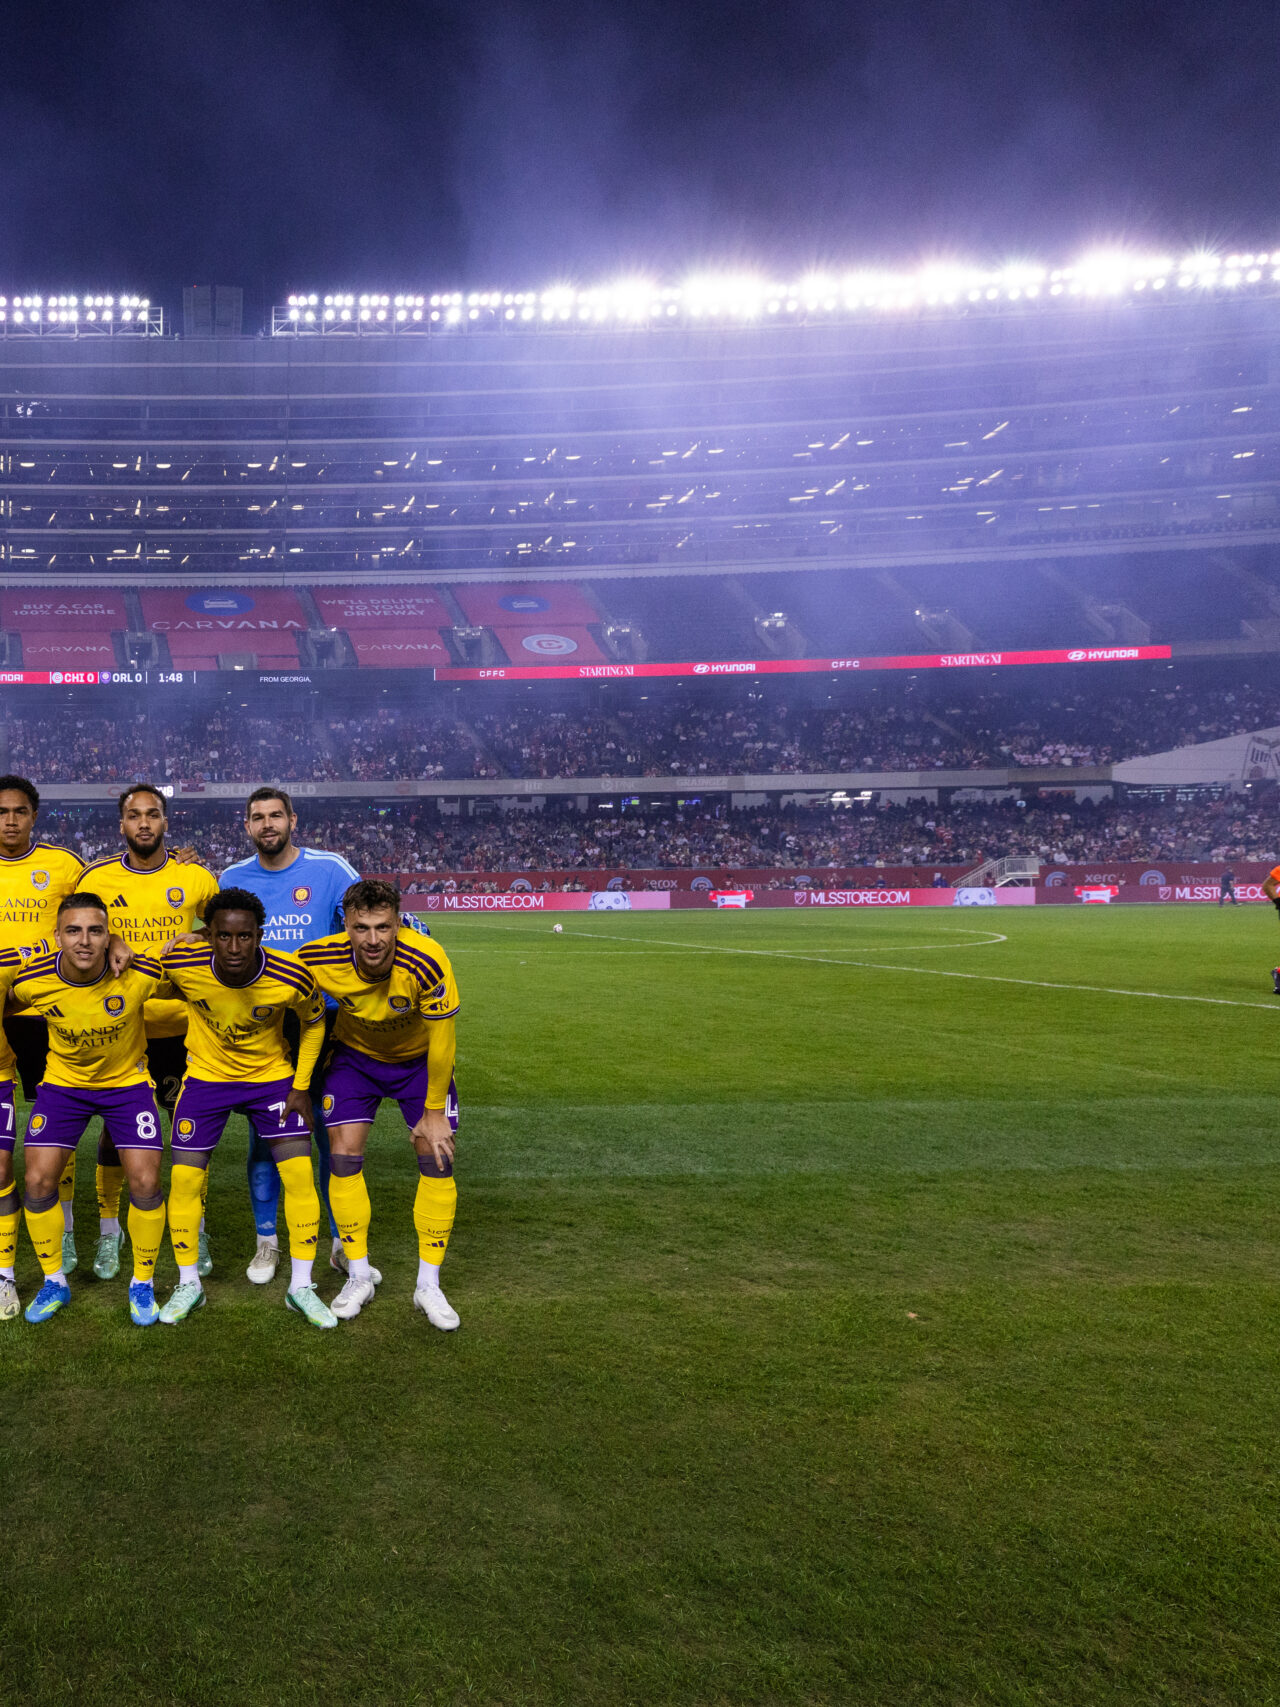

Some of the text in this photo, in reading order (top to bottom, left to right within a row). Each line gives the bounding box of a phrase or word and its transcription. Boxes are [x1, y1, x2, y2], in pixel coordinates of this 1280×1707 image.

[343, 609, 426, 617] DRIVEWAY
[152, 620, 301, 630] CARVANA
[940, 653, 1002, 666] STARTING XI
[1087, 649, 1139, 660] HYUNDAI
[579, 666, 634, 677] STARTING XI
[711, 663, 756, 672] HYUNDAI
[64, 673, 95, 683] CHI 0
[112, 673, 143, 683] ORL 0
[158, 673, 184, 683] 1:48
[279, 784, 317, 795] FIELD
[112, 914, 184, 929] ORLANDO
[122, 929, 177, 942] HEALTH
[1, 1102, 14, 1132] 7
[136, 1111, 157, 1139] 8
